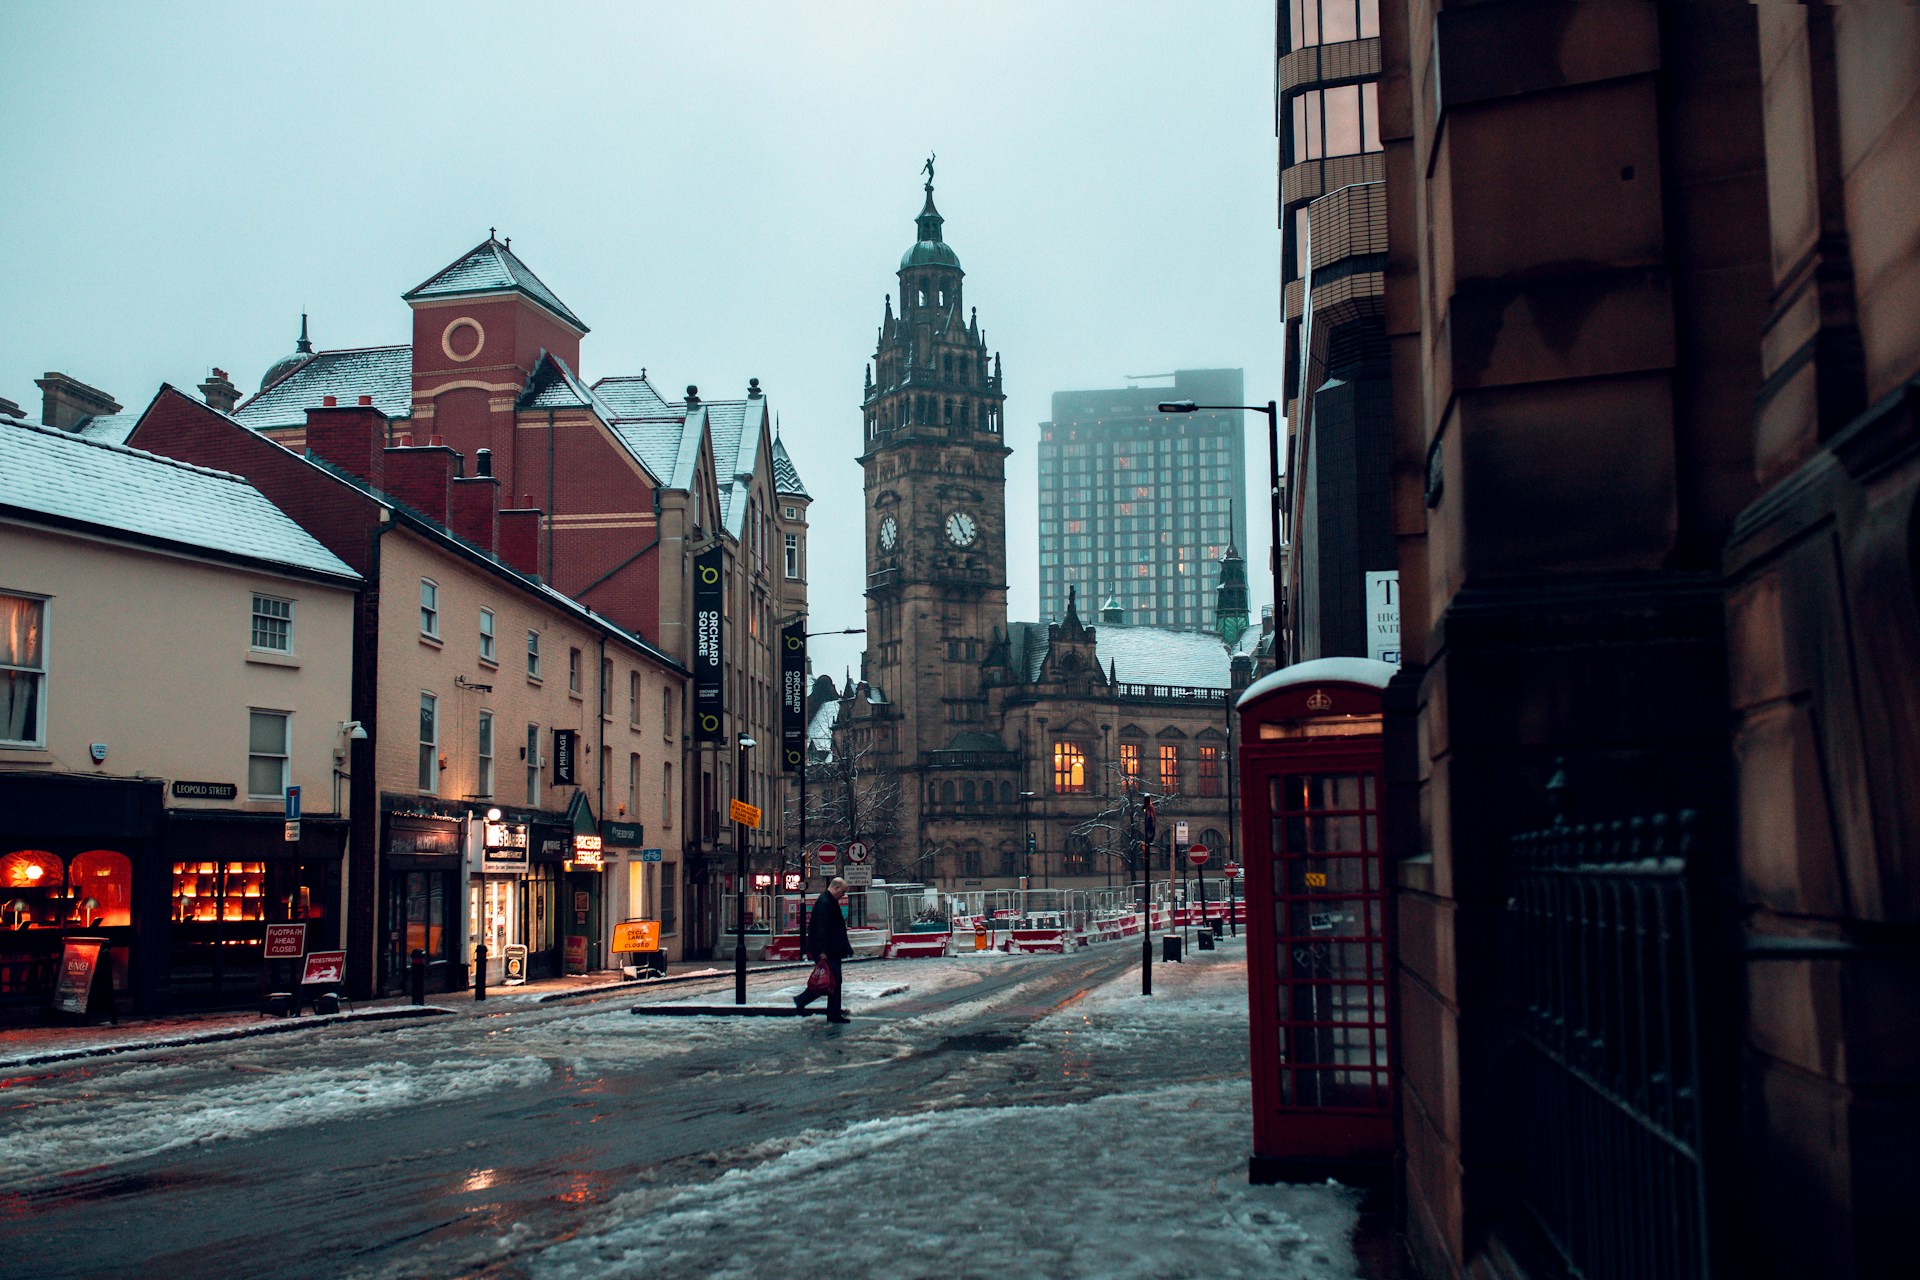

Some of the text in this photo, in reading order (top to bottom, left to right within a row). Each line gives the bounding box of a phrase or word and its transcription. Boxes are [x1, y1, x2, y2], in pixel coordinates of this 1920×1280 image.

[699, 611, 708, 656] SQUARE
[709, 611, 719, 666] ORCHARD
[176, 785, 232, 795] LEOPOLD STREET
[269, 928, 303, 936] FOOTPATH
